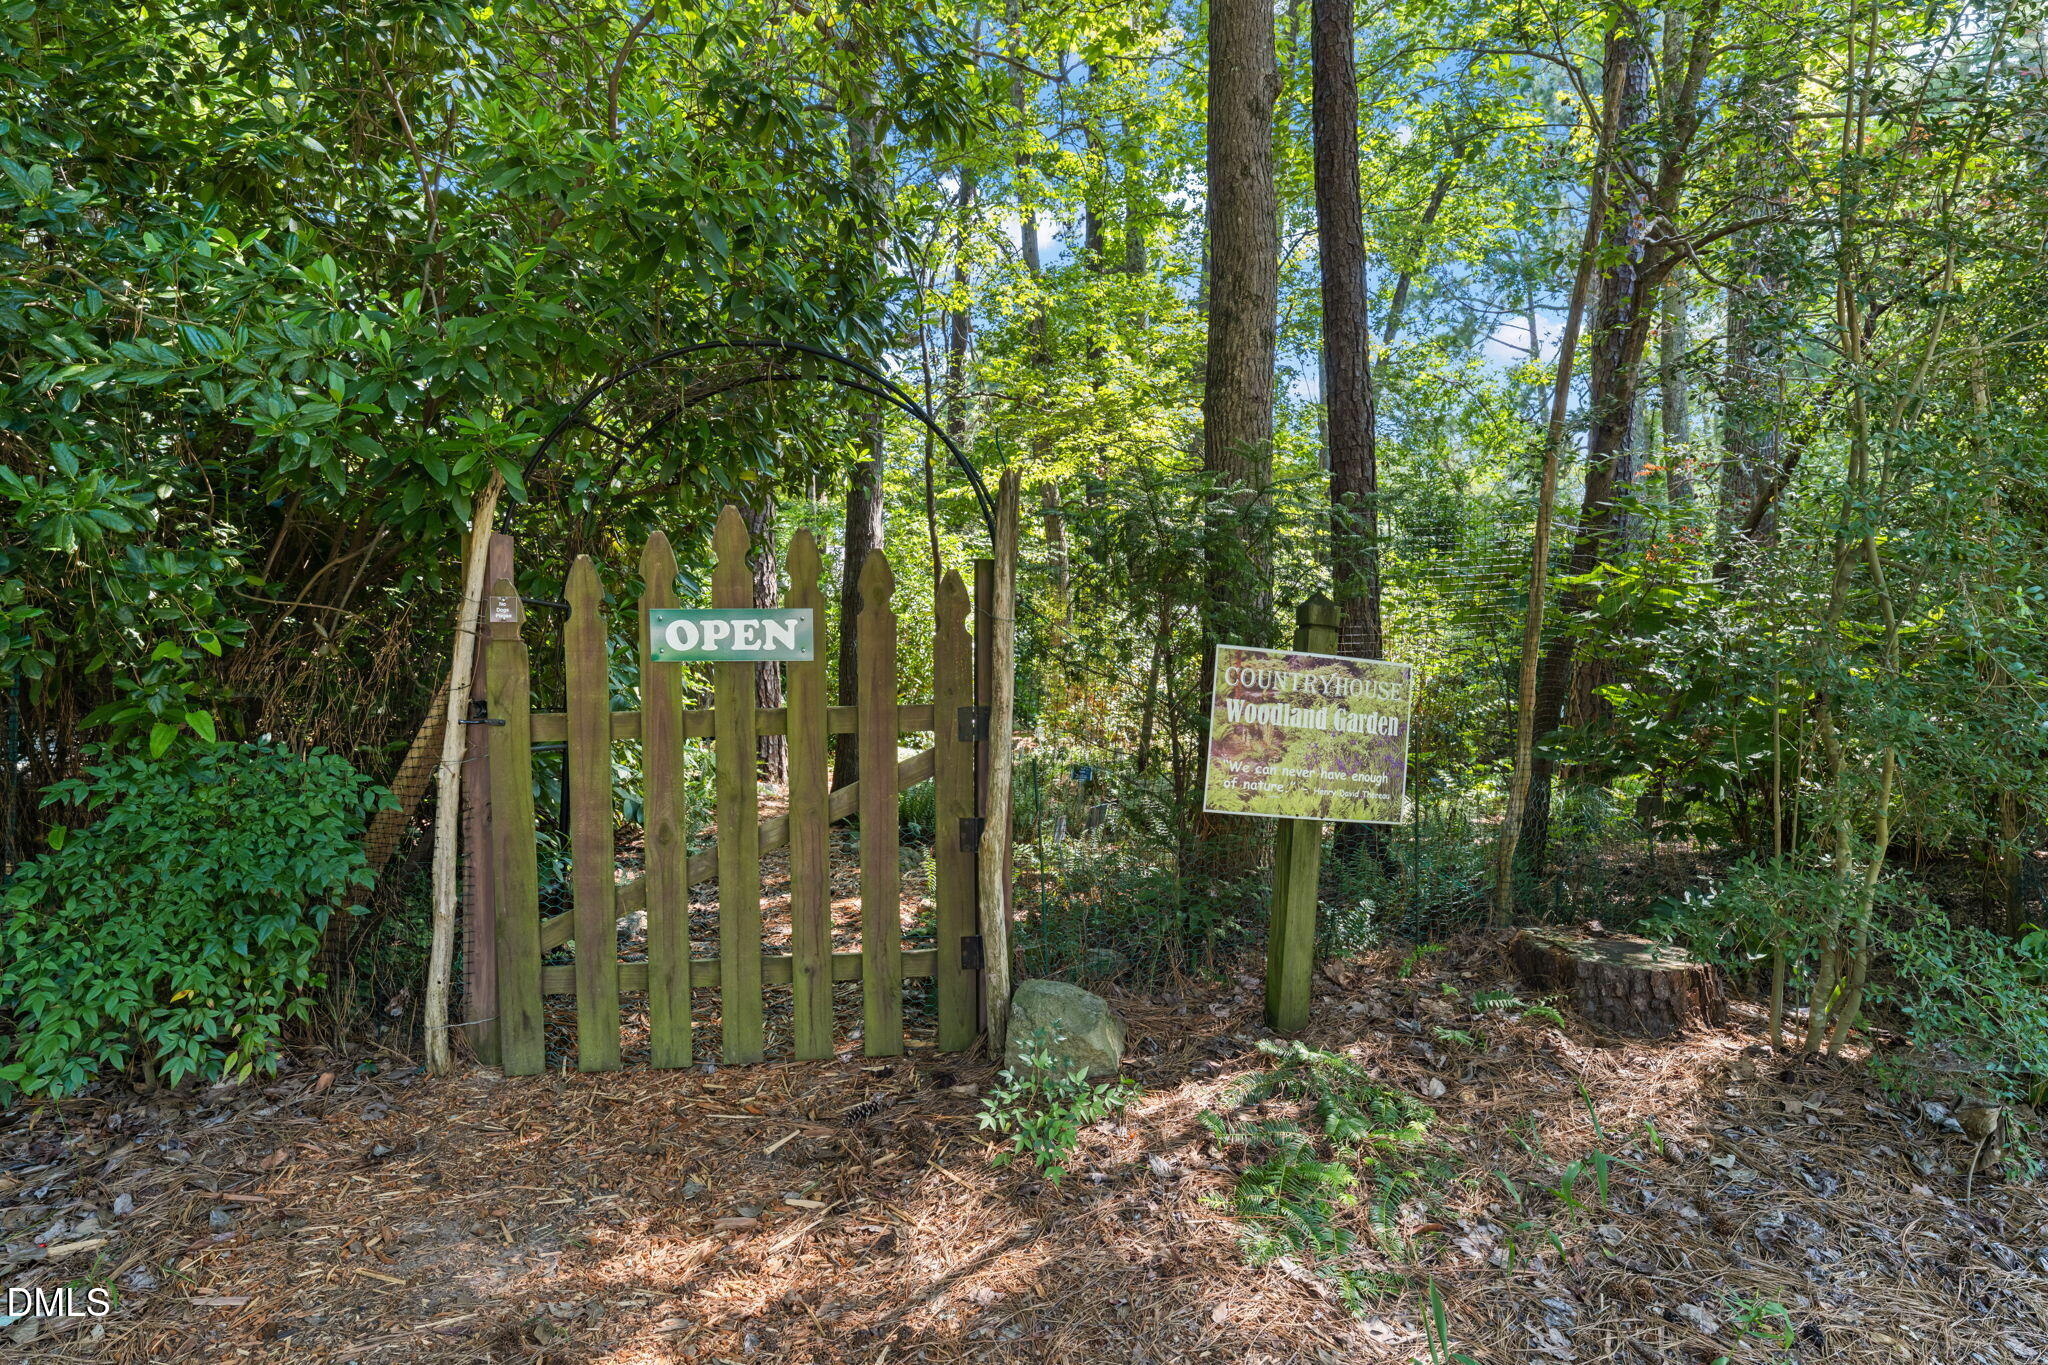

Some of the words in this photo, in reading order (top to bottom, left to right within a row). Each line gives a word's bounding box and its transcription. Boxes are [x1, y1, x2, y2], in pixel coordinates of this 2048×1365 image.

[665, 619, 798, 651] OPEN
[1224, 666, 1402, 701] COUNTRYHOUSE
[1226, 698, 1328, 731] Woodland
[1333, 707, 1399, 737] Garden
[1223, 777, 1238, 790] of
[1313, 787, 1337, 797] Henry
[1339, 789, 1360, 798] David
[1362, 790, 1390, 800] Thoreau
[1255, 765, 1277, 776] can
[1282, 767, 1315, 778] never
[1320, 766, 1347, 780] have
[1351, 771, 1389, 787] enough
